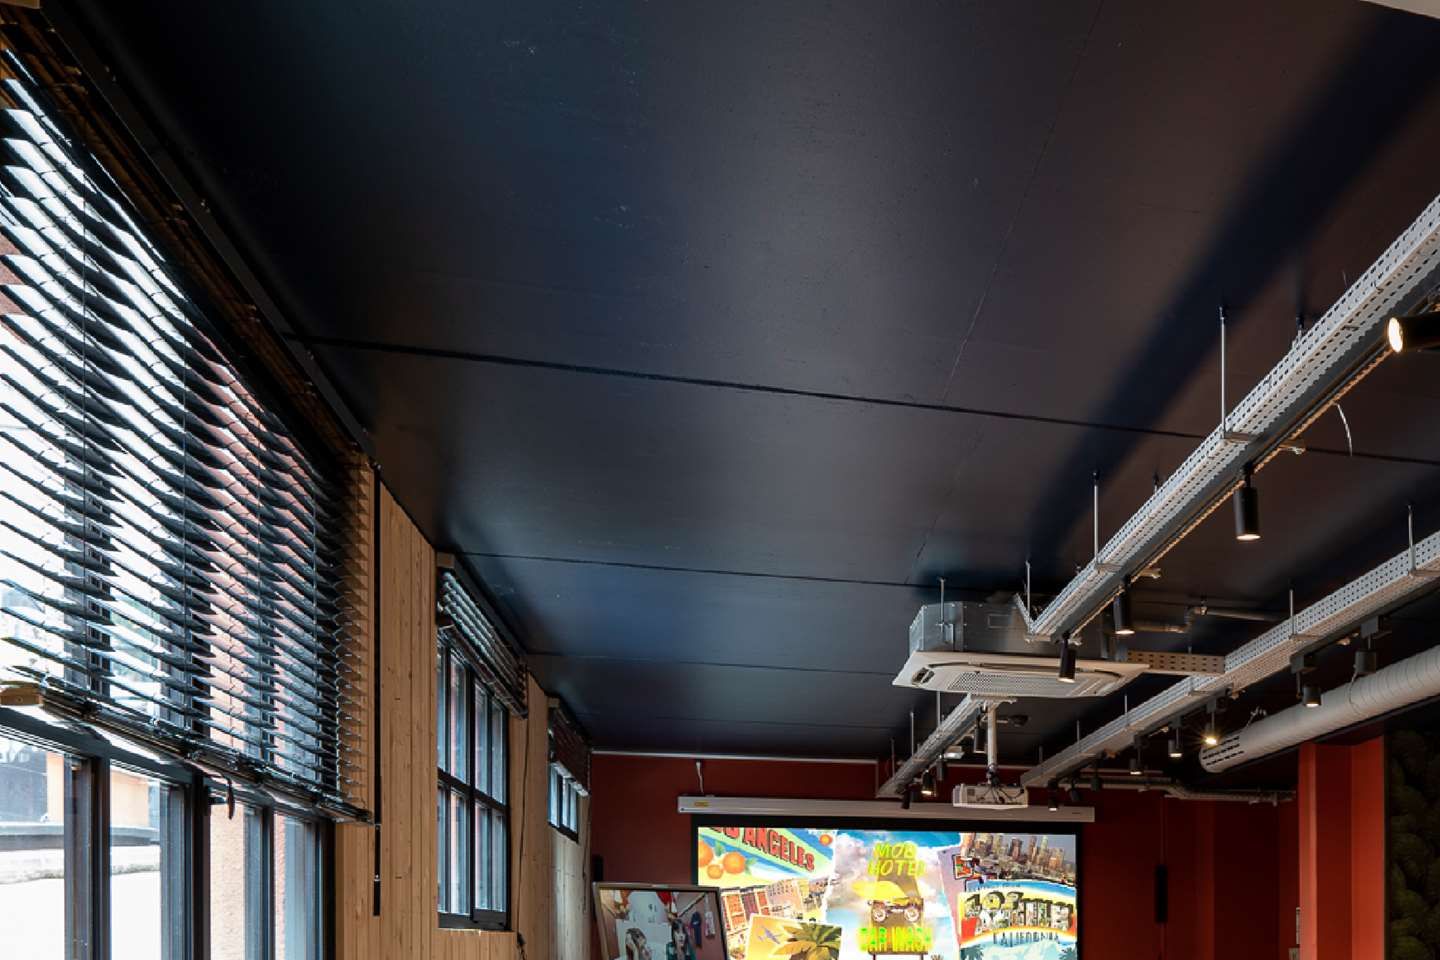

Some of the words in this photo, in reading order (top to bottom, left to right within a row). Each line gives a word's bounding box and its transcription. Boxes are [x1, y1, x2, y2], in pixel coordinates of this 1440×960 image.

[743, 827, 815, 873] ANGELES
[873, 843, 917, 859] MOB
[867, 860, 925, 876] HOTEL
